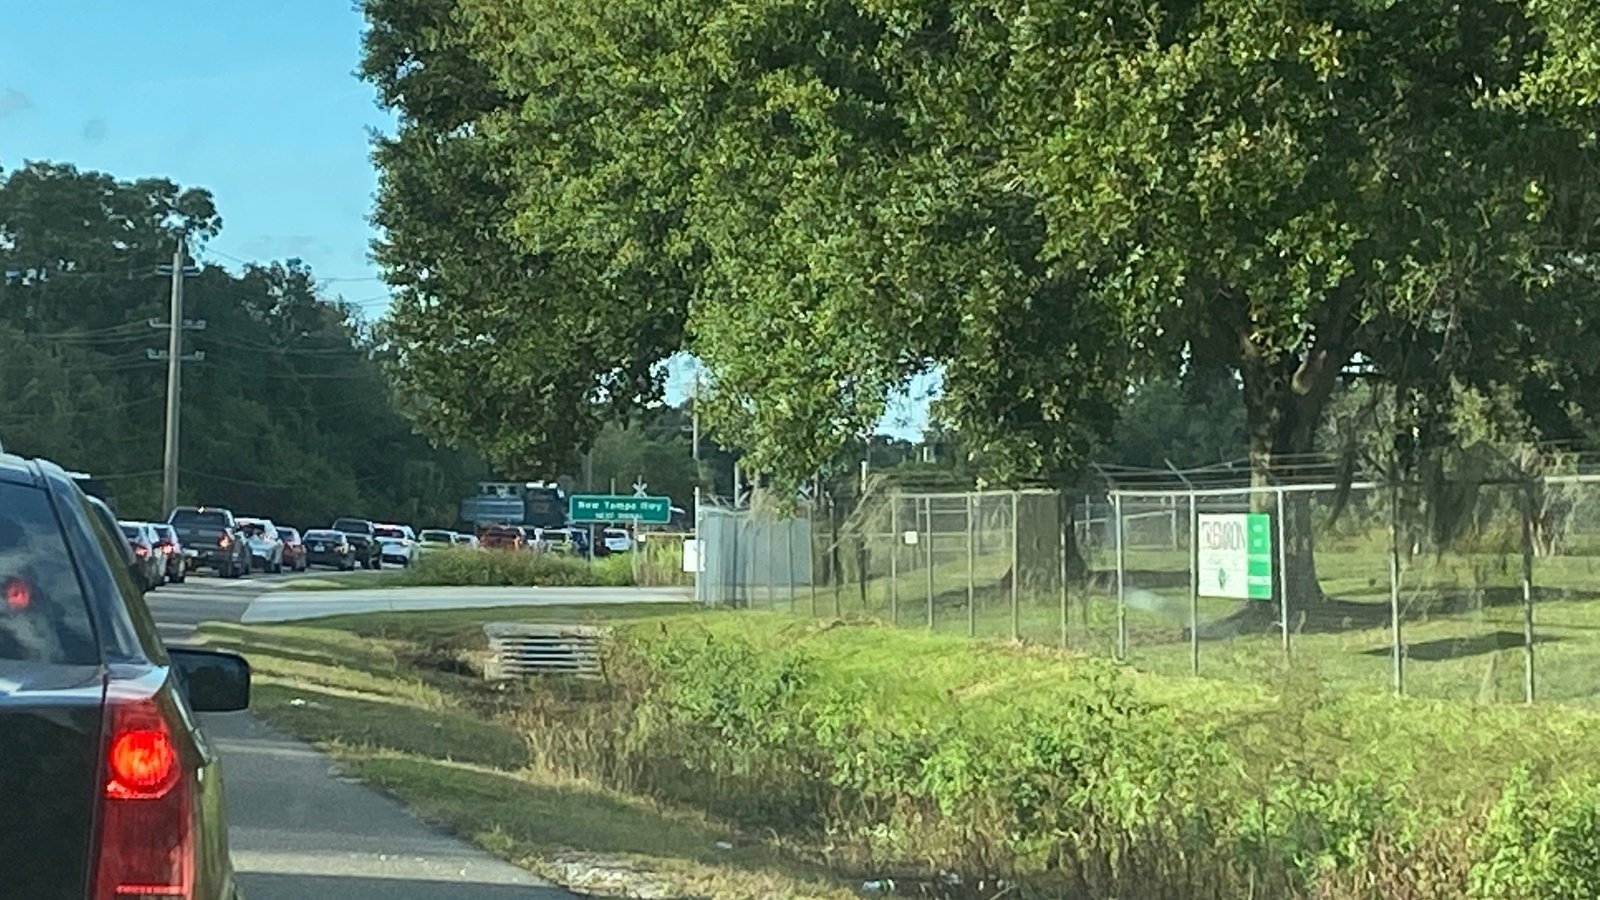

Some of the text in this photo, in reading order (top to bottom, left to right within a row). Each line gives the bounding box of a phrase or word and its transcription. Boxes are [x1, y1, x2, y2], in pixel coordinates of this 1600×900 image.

[578, 501, 663, 512] New Tampa Hwy
